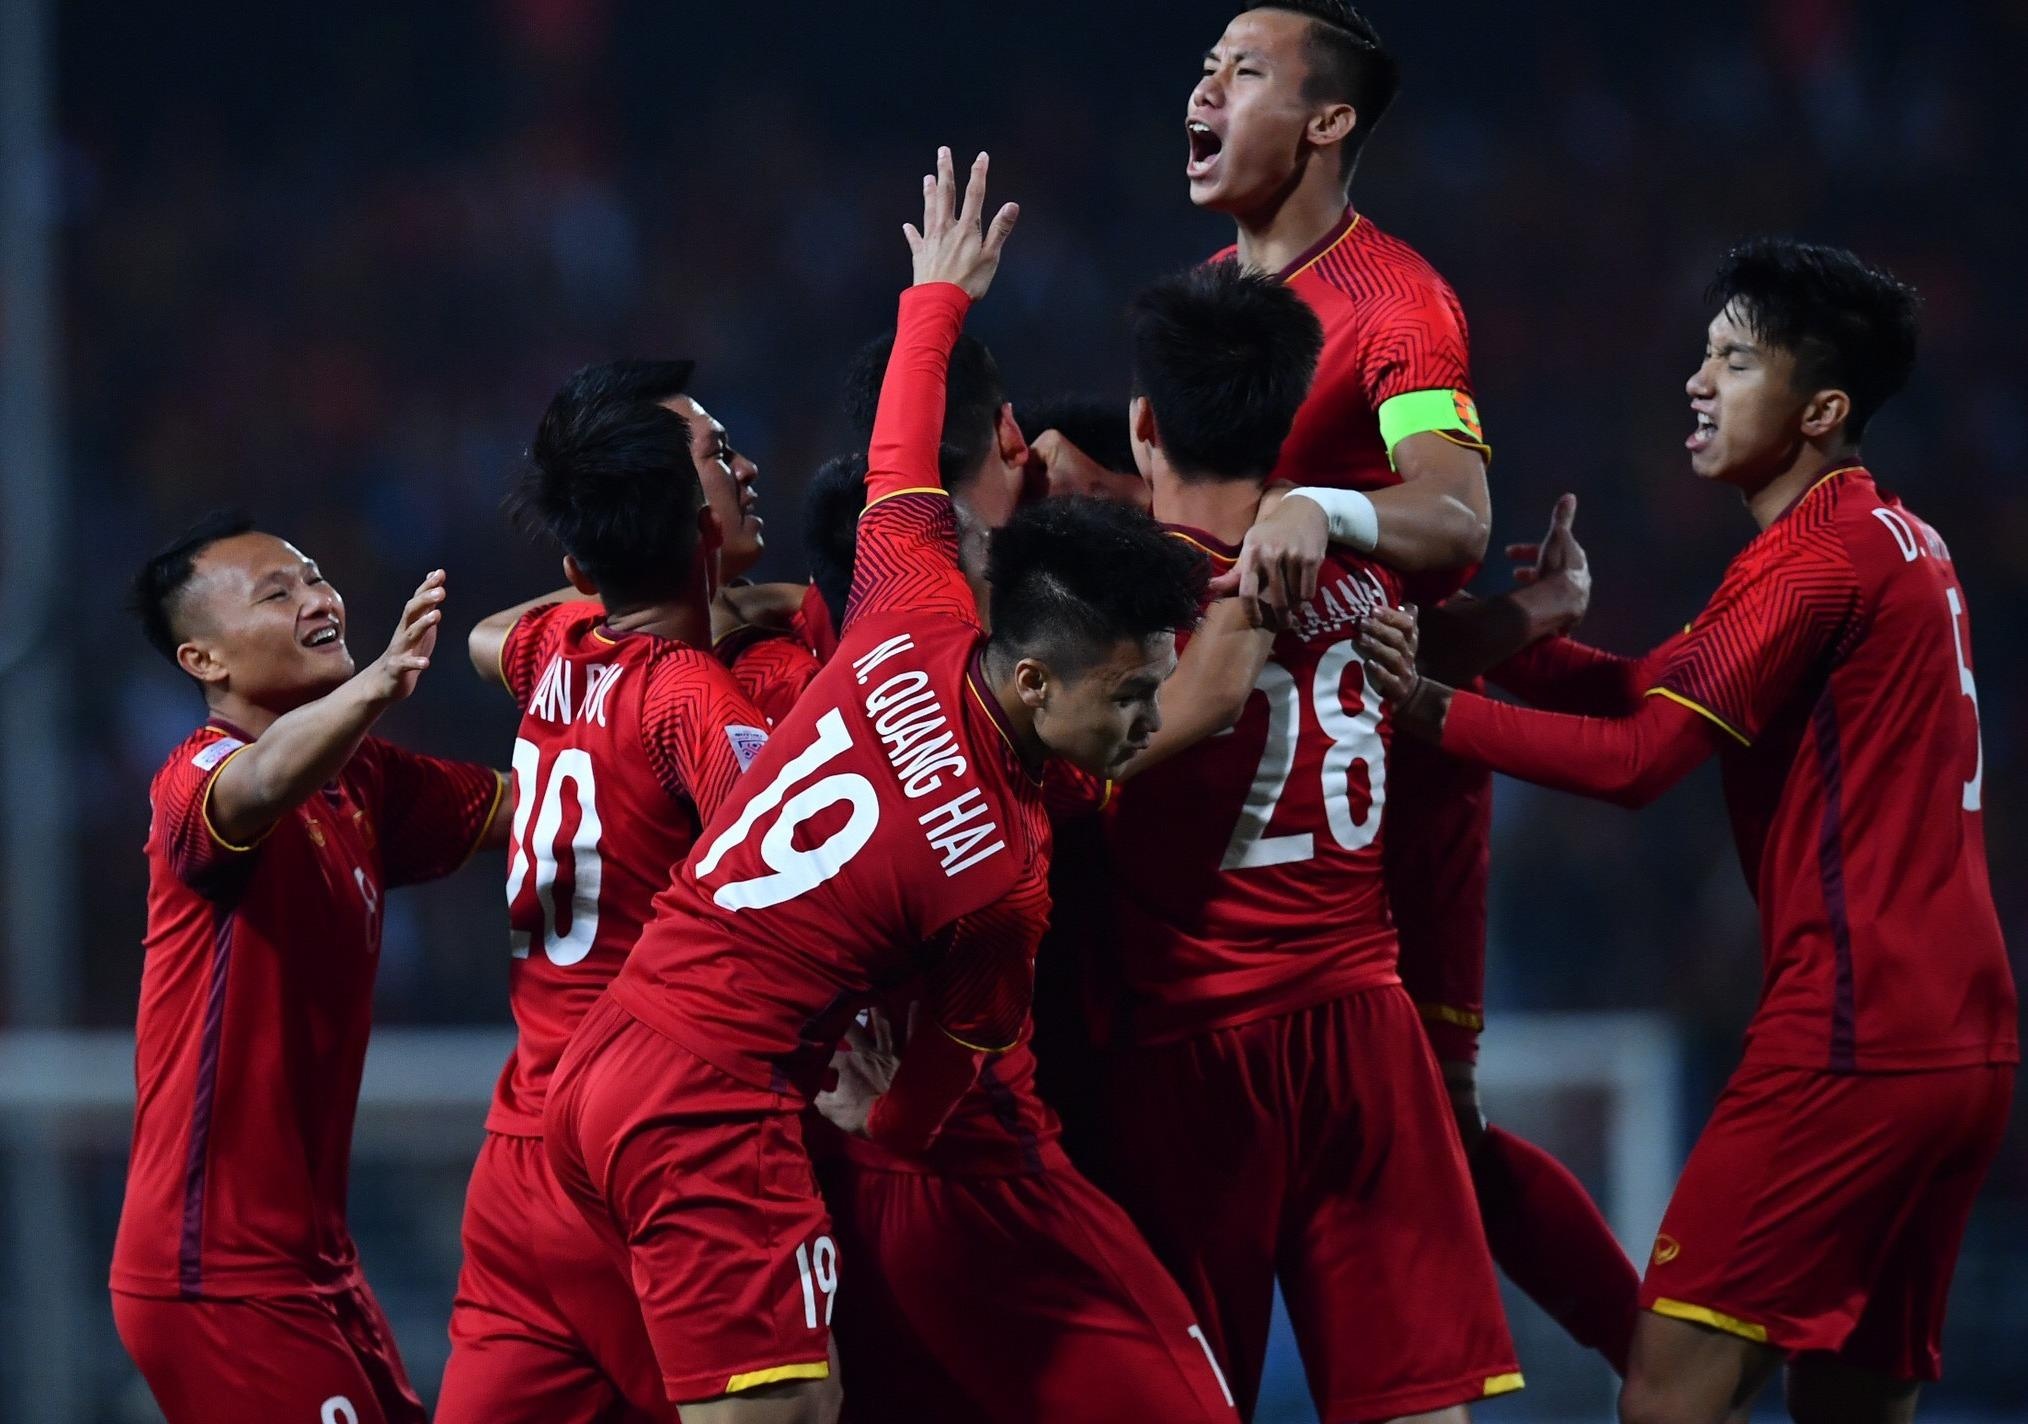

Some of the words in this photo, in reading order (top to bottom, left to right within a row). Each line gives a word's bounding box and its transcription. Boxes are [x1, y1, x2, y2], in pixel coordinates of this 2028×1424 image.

[852, 633, 914, 685] N.
[865, 671, 967, 798] QUANG
[1211, 638, 1387, 871] 28
[695, 706, 880, 912] 19
[918, 787, 1005, 877] HAI
[796, 1235, 838, 1329] 19
